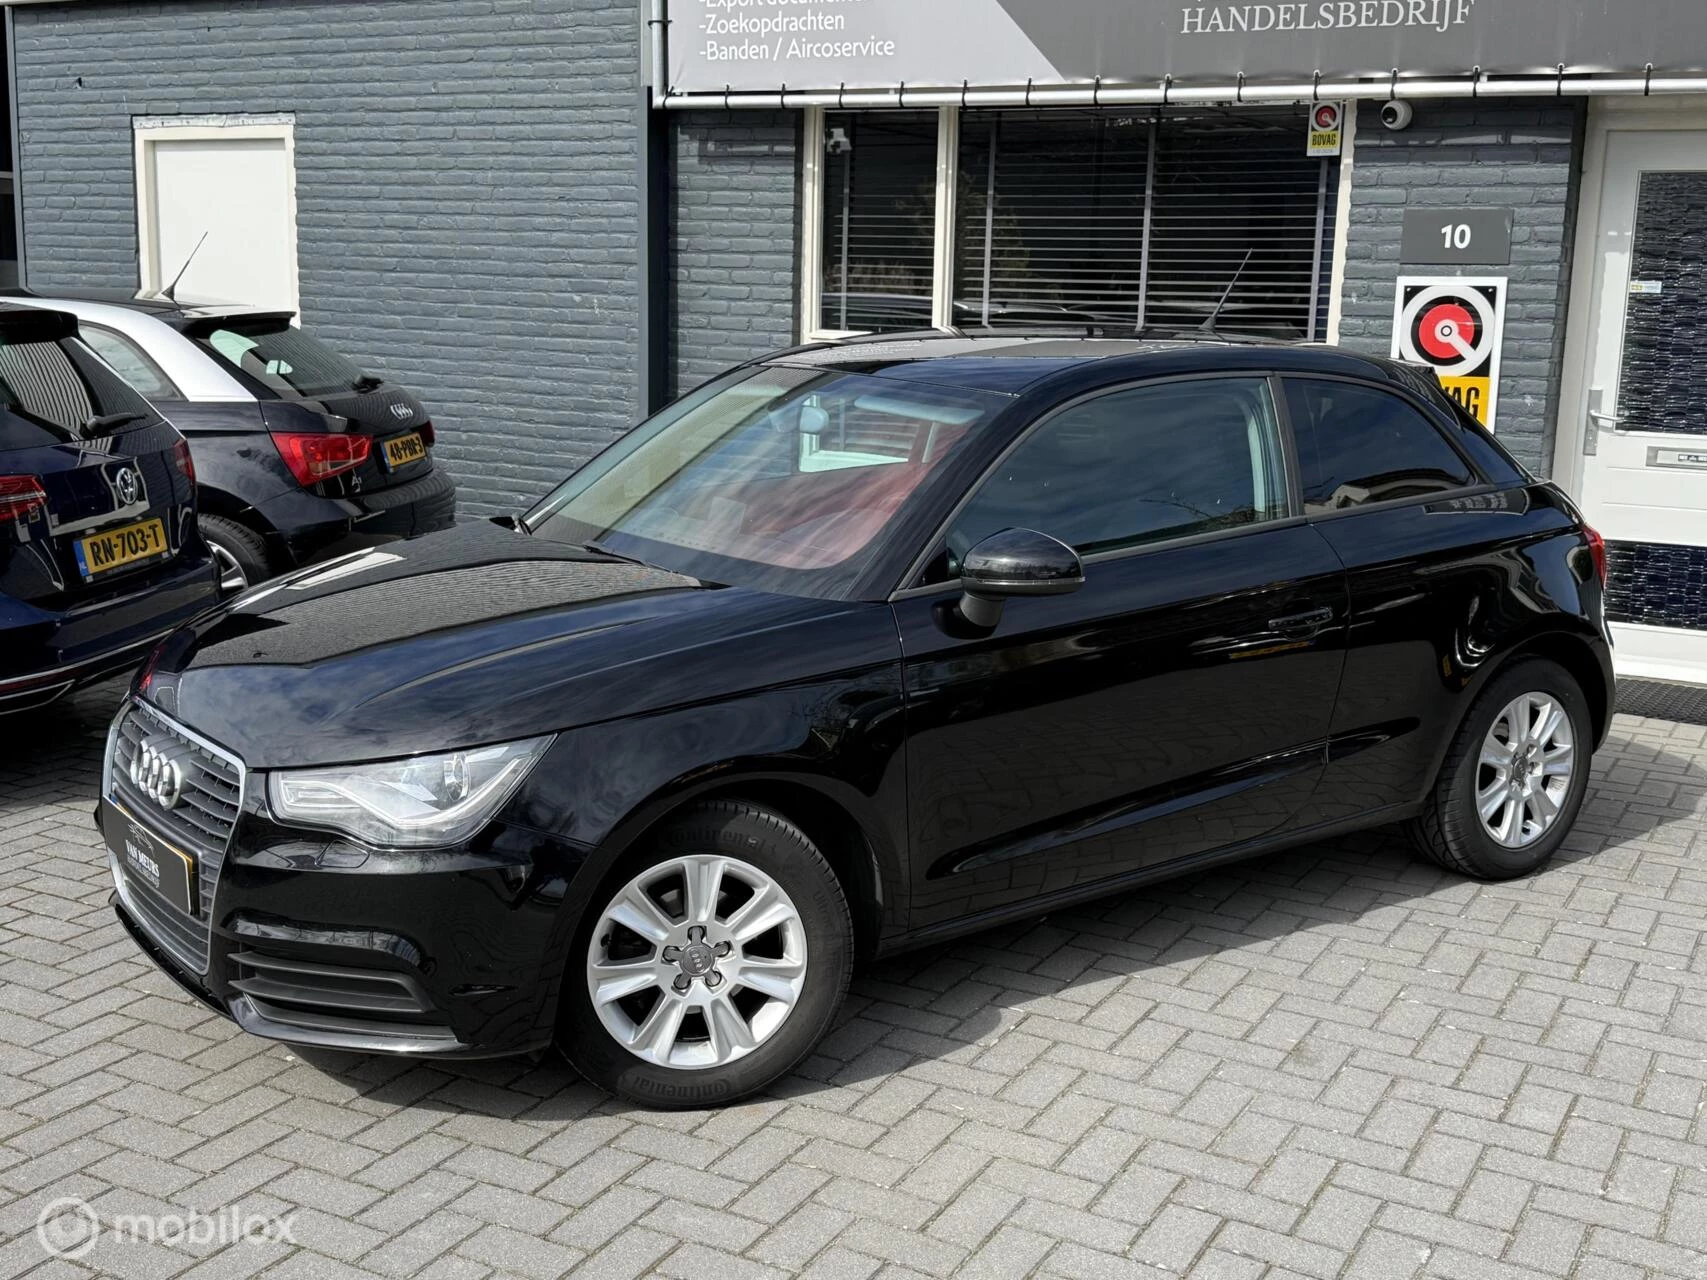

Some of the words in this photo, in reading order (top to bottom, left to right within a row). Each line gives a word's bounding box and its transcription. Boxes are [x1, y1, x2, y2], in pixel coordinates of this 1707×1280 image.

[699, 9, 845, 38] -Zoekopdrachten
[1180, 0, 1474, 32] HANDELSBEDRIJF
[699, 38, 769, 61] -Banden
[786, 35, 895, 59] Aircoservice
[1311, 133, 1337, 147] BOVAG
[1441, 224, 1471, 249] 10
[90, 523, 159, 566] RN-703-T
